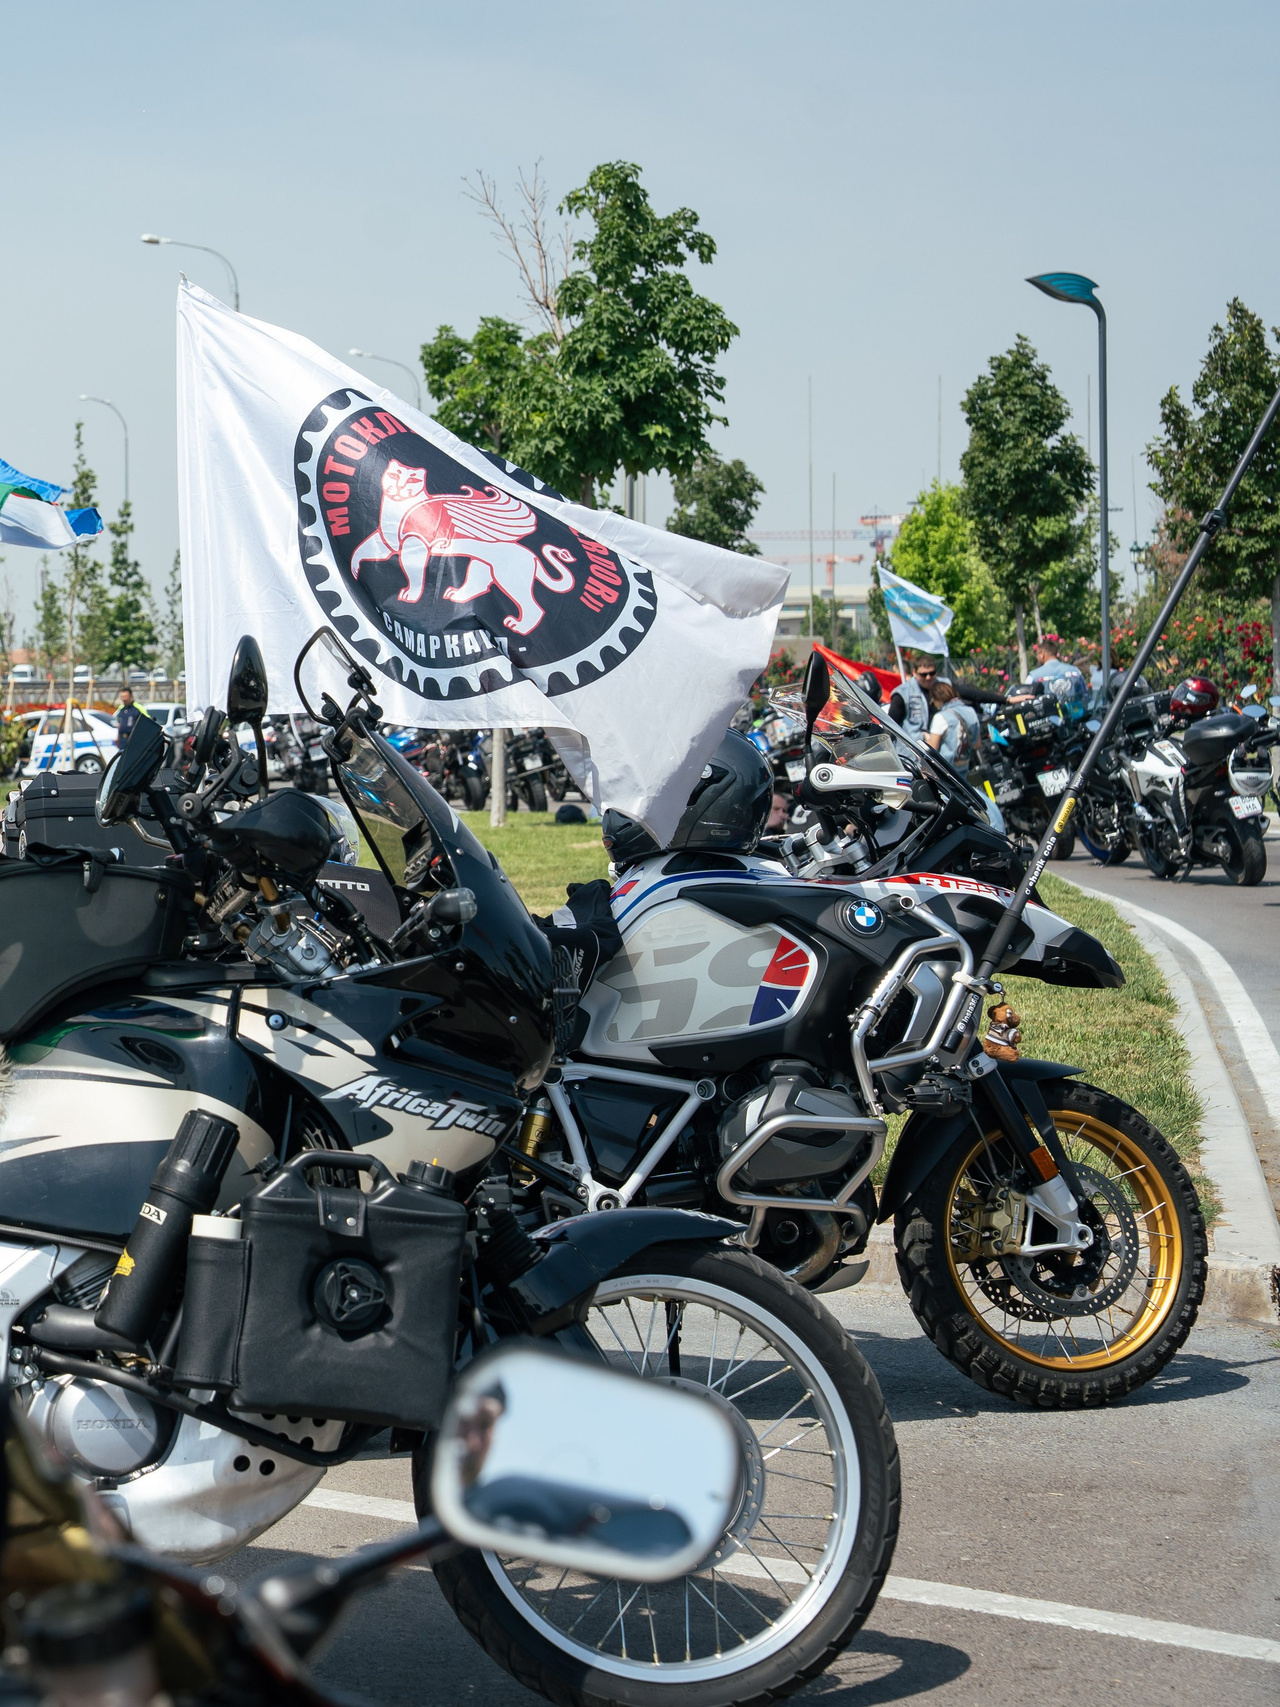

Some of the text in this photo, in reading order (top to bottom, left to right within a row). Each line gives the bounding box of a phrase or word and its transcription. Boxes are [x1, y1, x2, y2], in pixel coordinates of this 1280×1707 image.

[322, 411, 416, 537] МОТОКЛ
[851, 901, 879, 913] BMW
[320, 1074, 507, 1137] Africa Twin
[76, 1417, 151, 1430] HONDA
